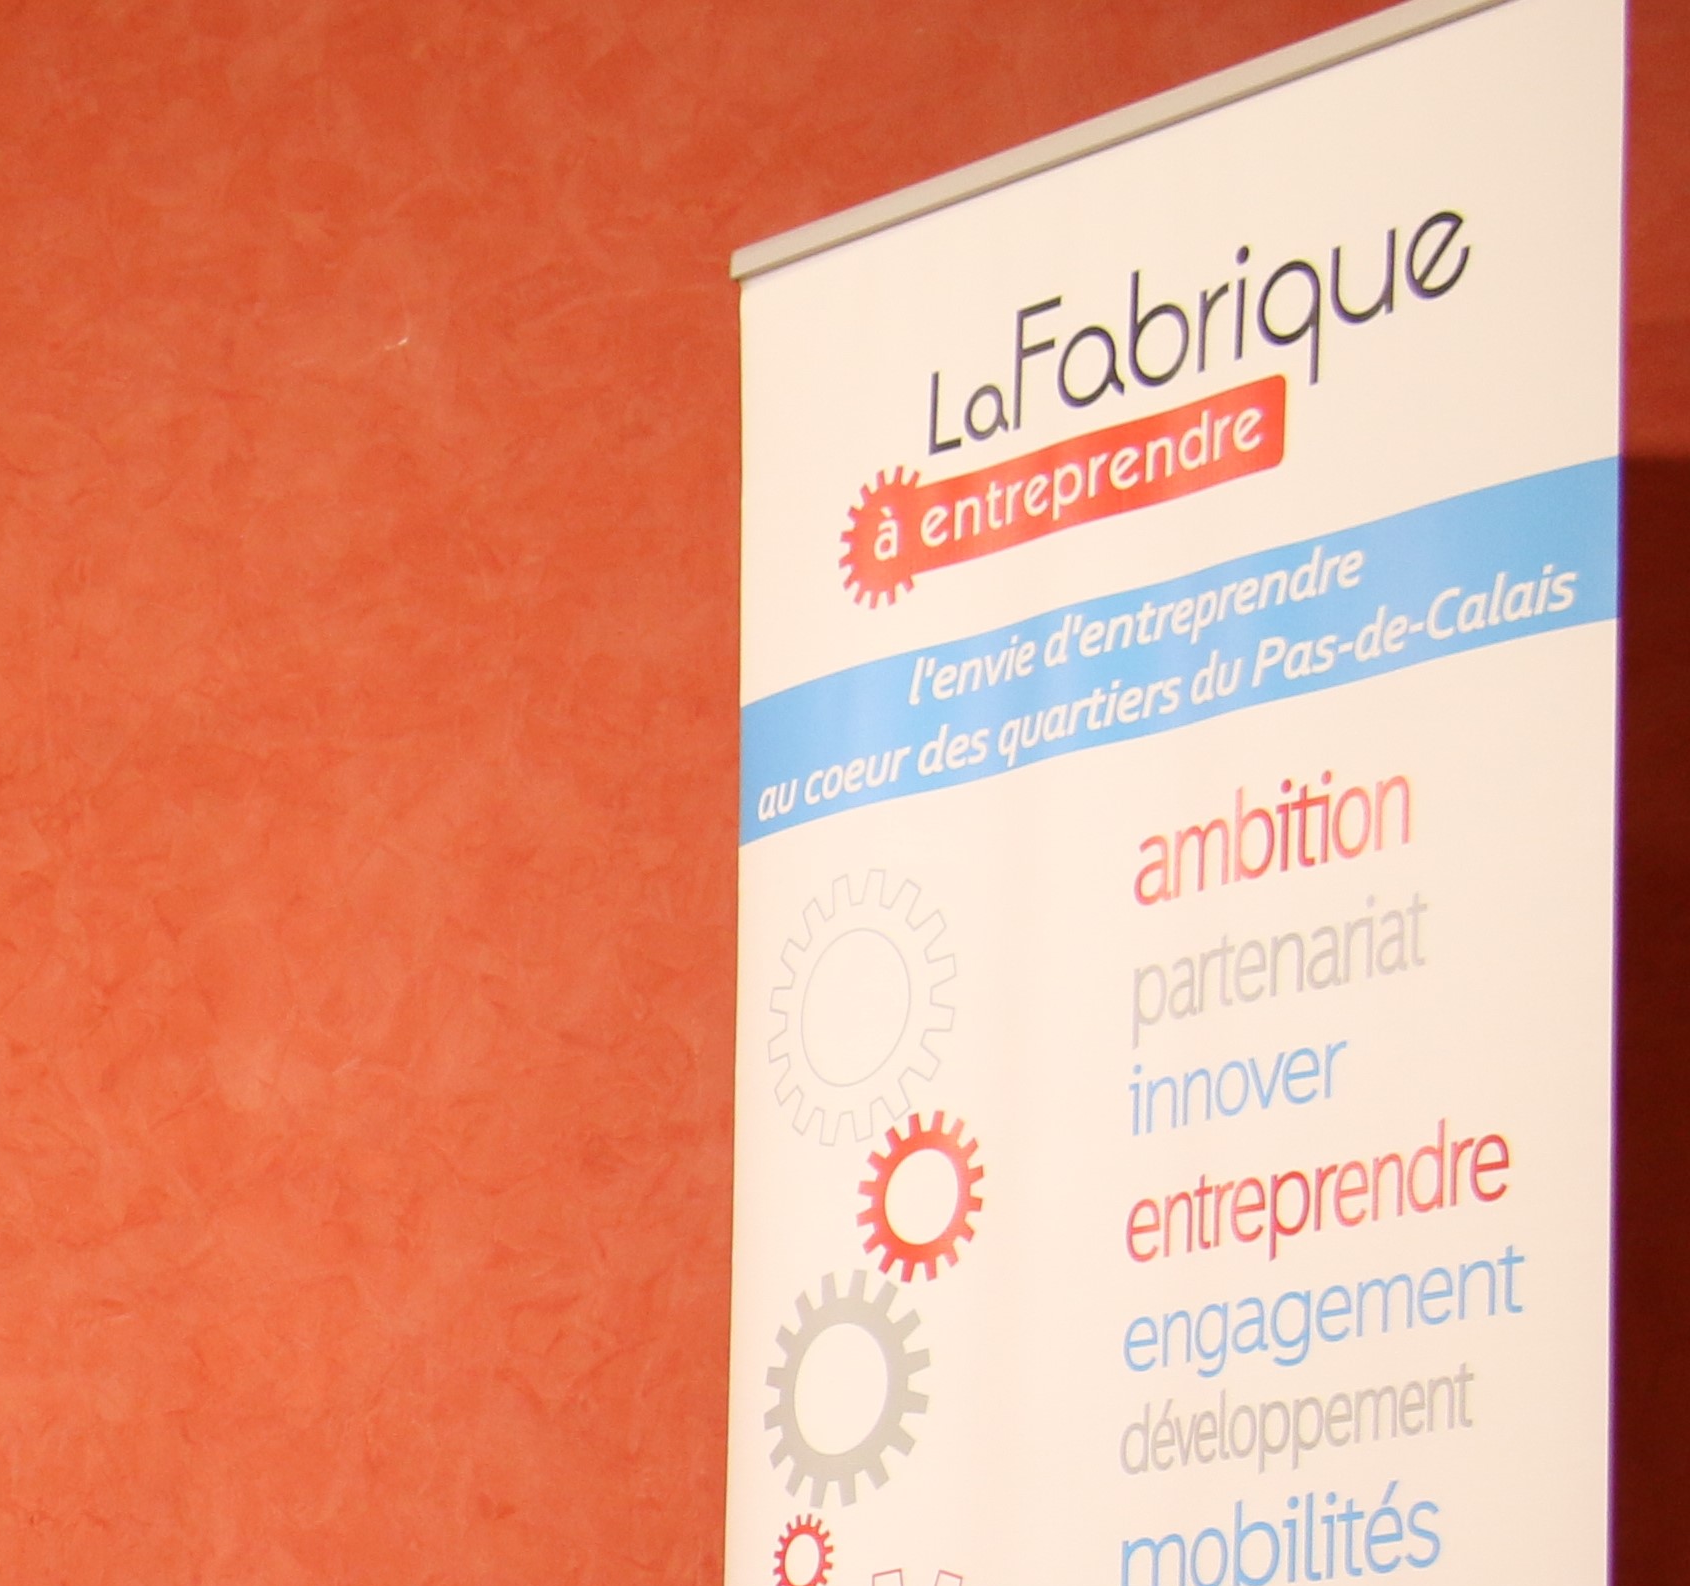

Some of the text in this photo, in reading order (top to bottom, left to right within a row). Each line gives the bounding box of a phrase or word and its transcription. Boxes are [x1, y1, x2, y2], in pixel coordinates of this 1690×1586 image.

[873, 406, 1265, 562] à entreprendre
[757, 563, 1579, 822] au coeur des quartiers du Pas-de-Calais
[908, 544, 1365, 706] l'envie d'entreprendre
[1132, 769, 1413, 907] ambition
[1131, 892, 1430, 1050] partenariat
[1128, 1037, 1348, 1137] innover
[1124, 1117, 1512, 1264] entreprendre
[1122, 1244, 1526, 1379] engagement
[1119, 1362, 1477, 1477] développement
